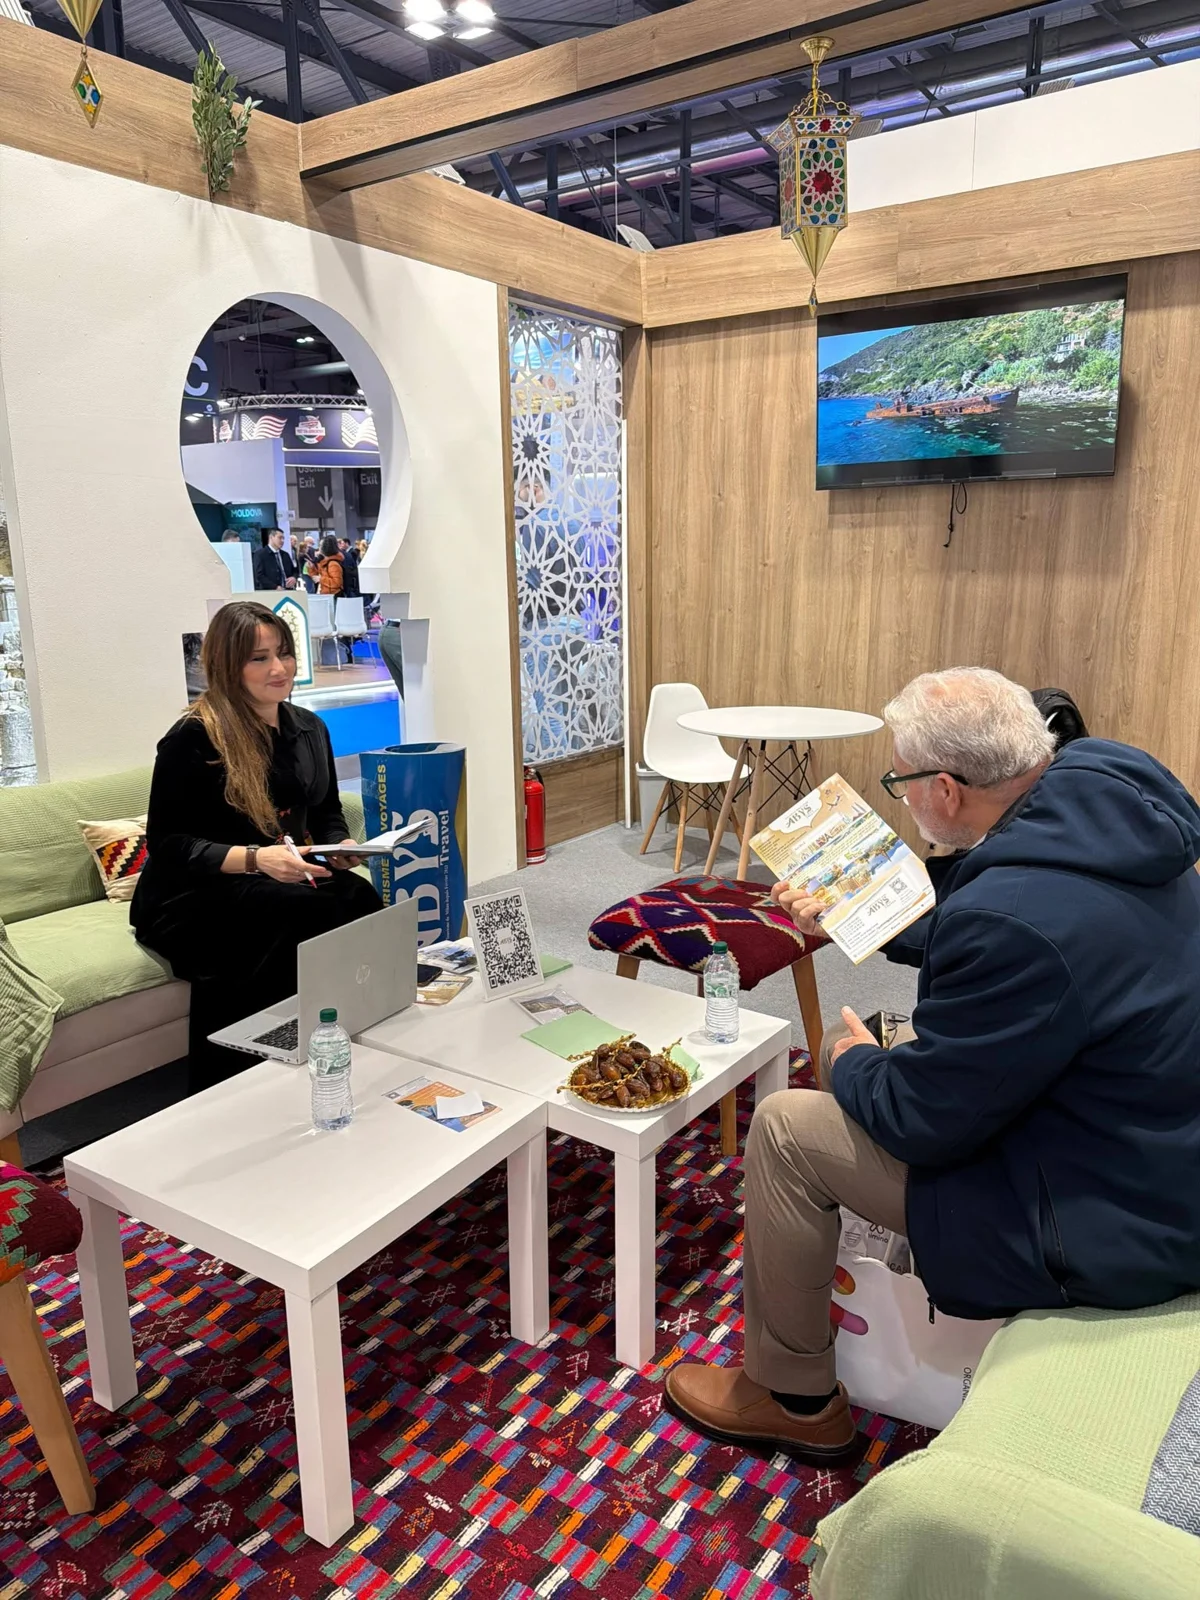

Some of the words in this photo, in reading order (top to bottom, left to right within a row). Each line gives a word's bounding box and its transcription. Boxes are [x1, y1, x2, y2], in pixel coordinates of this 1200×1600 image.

[299, 477, 316, 489] Exit
[360, 473, 379, 486] Exit
[231, 508, 263, 518] MOLDOVA
[378, 764, 388, 831] VOYAGES
[439, 810, 450, 866] Travel
